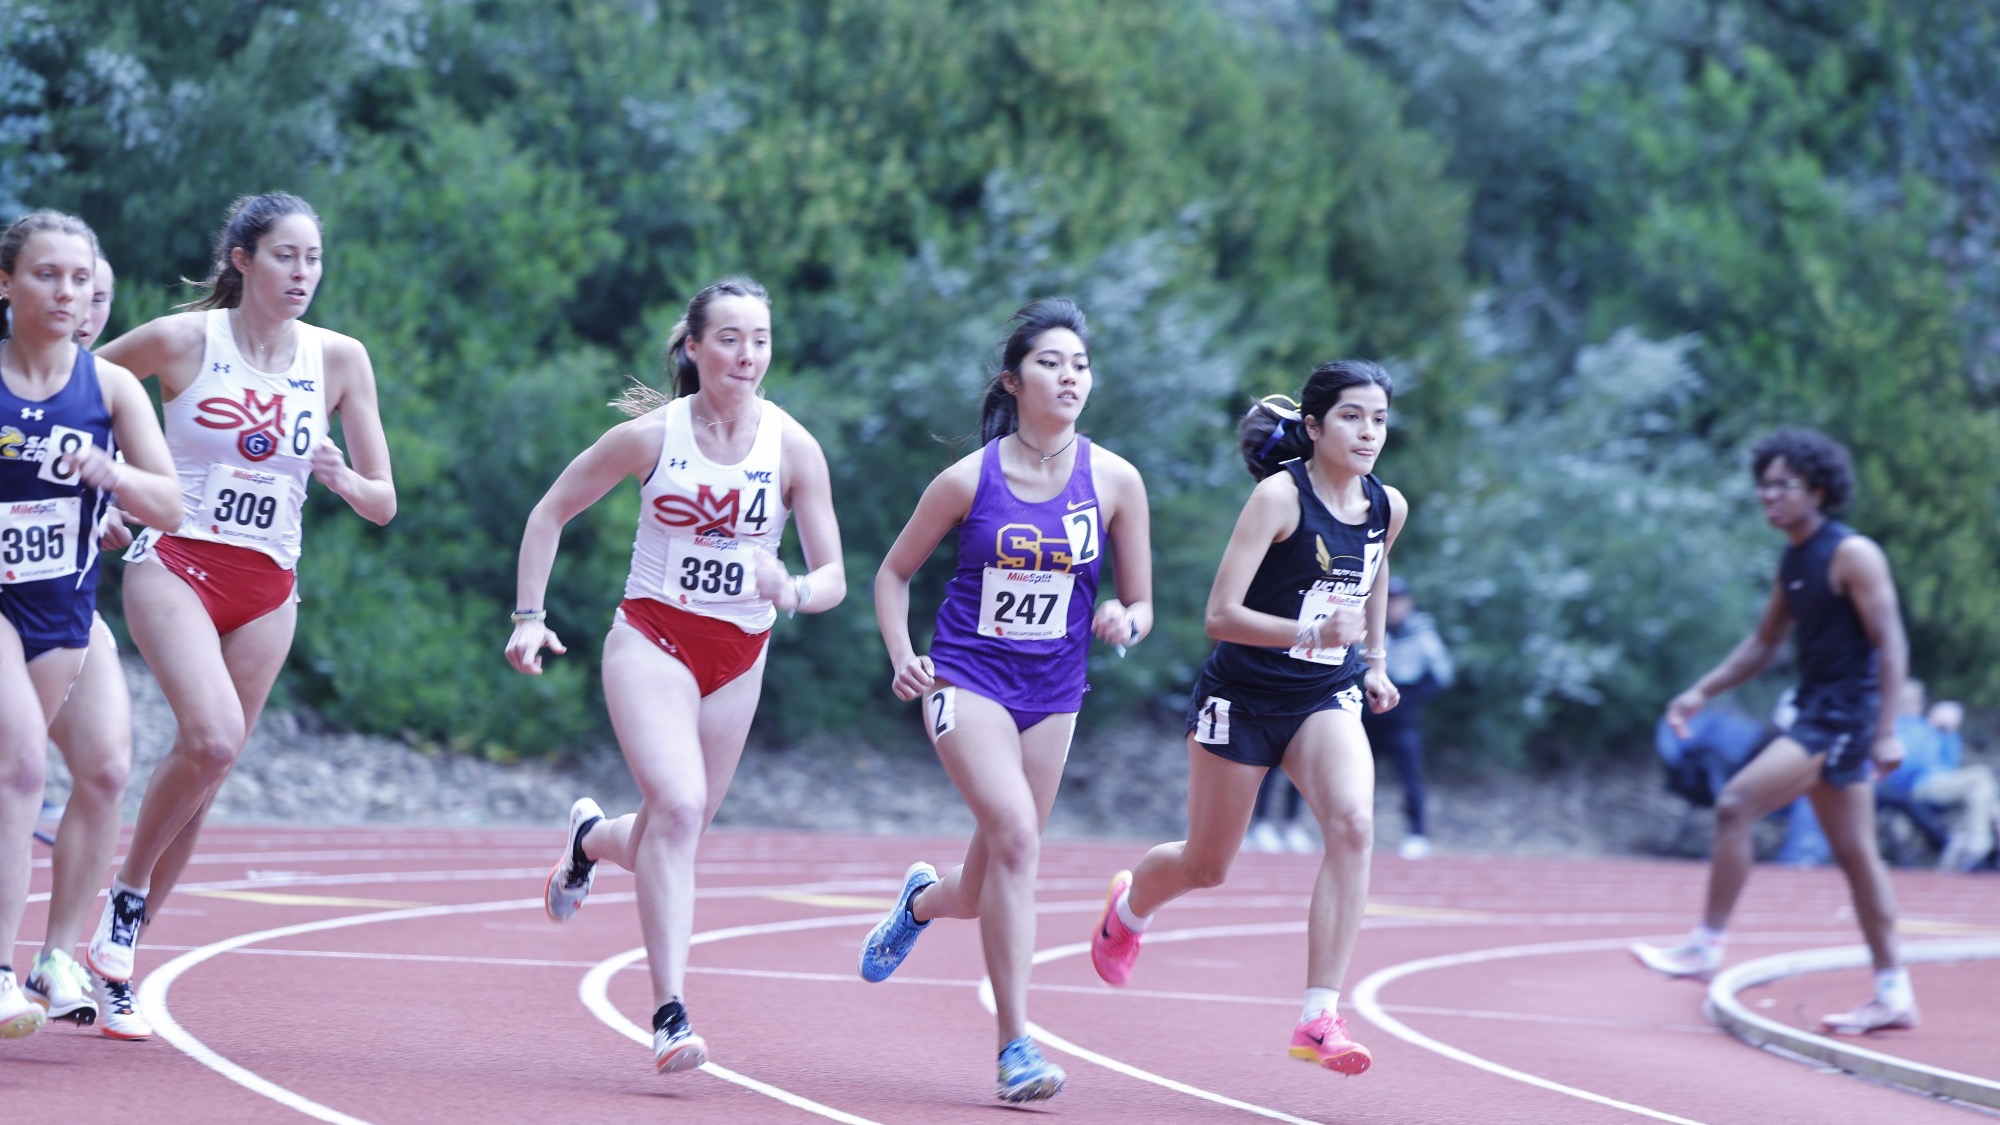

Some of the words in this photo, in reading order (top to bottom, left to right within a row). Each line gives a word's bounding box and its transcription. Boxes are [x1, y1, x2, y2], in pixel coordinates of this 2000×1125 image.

[293, 410, 312, 456] 6
[52, 432, 82, 480] 8
[214, 488, 277, 529] 309
[745, 488, 768, 531] 4
[1, 523, 65, 565] 395
[693, 537, 739, 551] MileSplit
[1072, 513, 1094, 560] 2
[680, 556, 744, 596] 339
[1007, 572, 1052, 584] MileSplit
[994, 591, 1059, 625] 247
[931, 692, 946, 735] 2
[1204, 702, 1217, 740] 1
